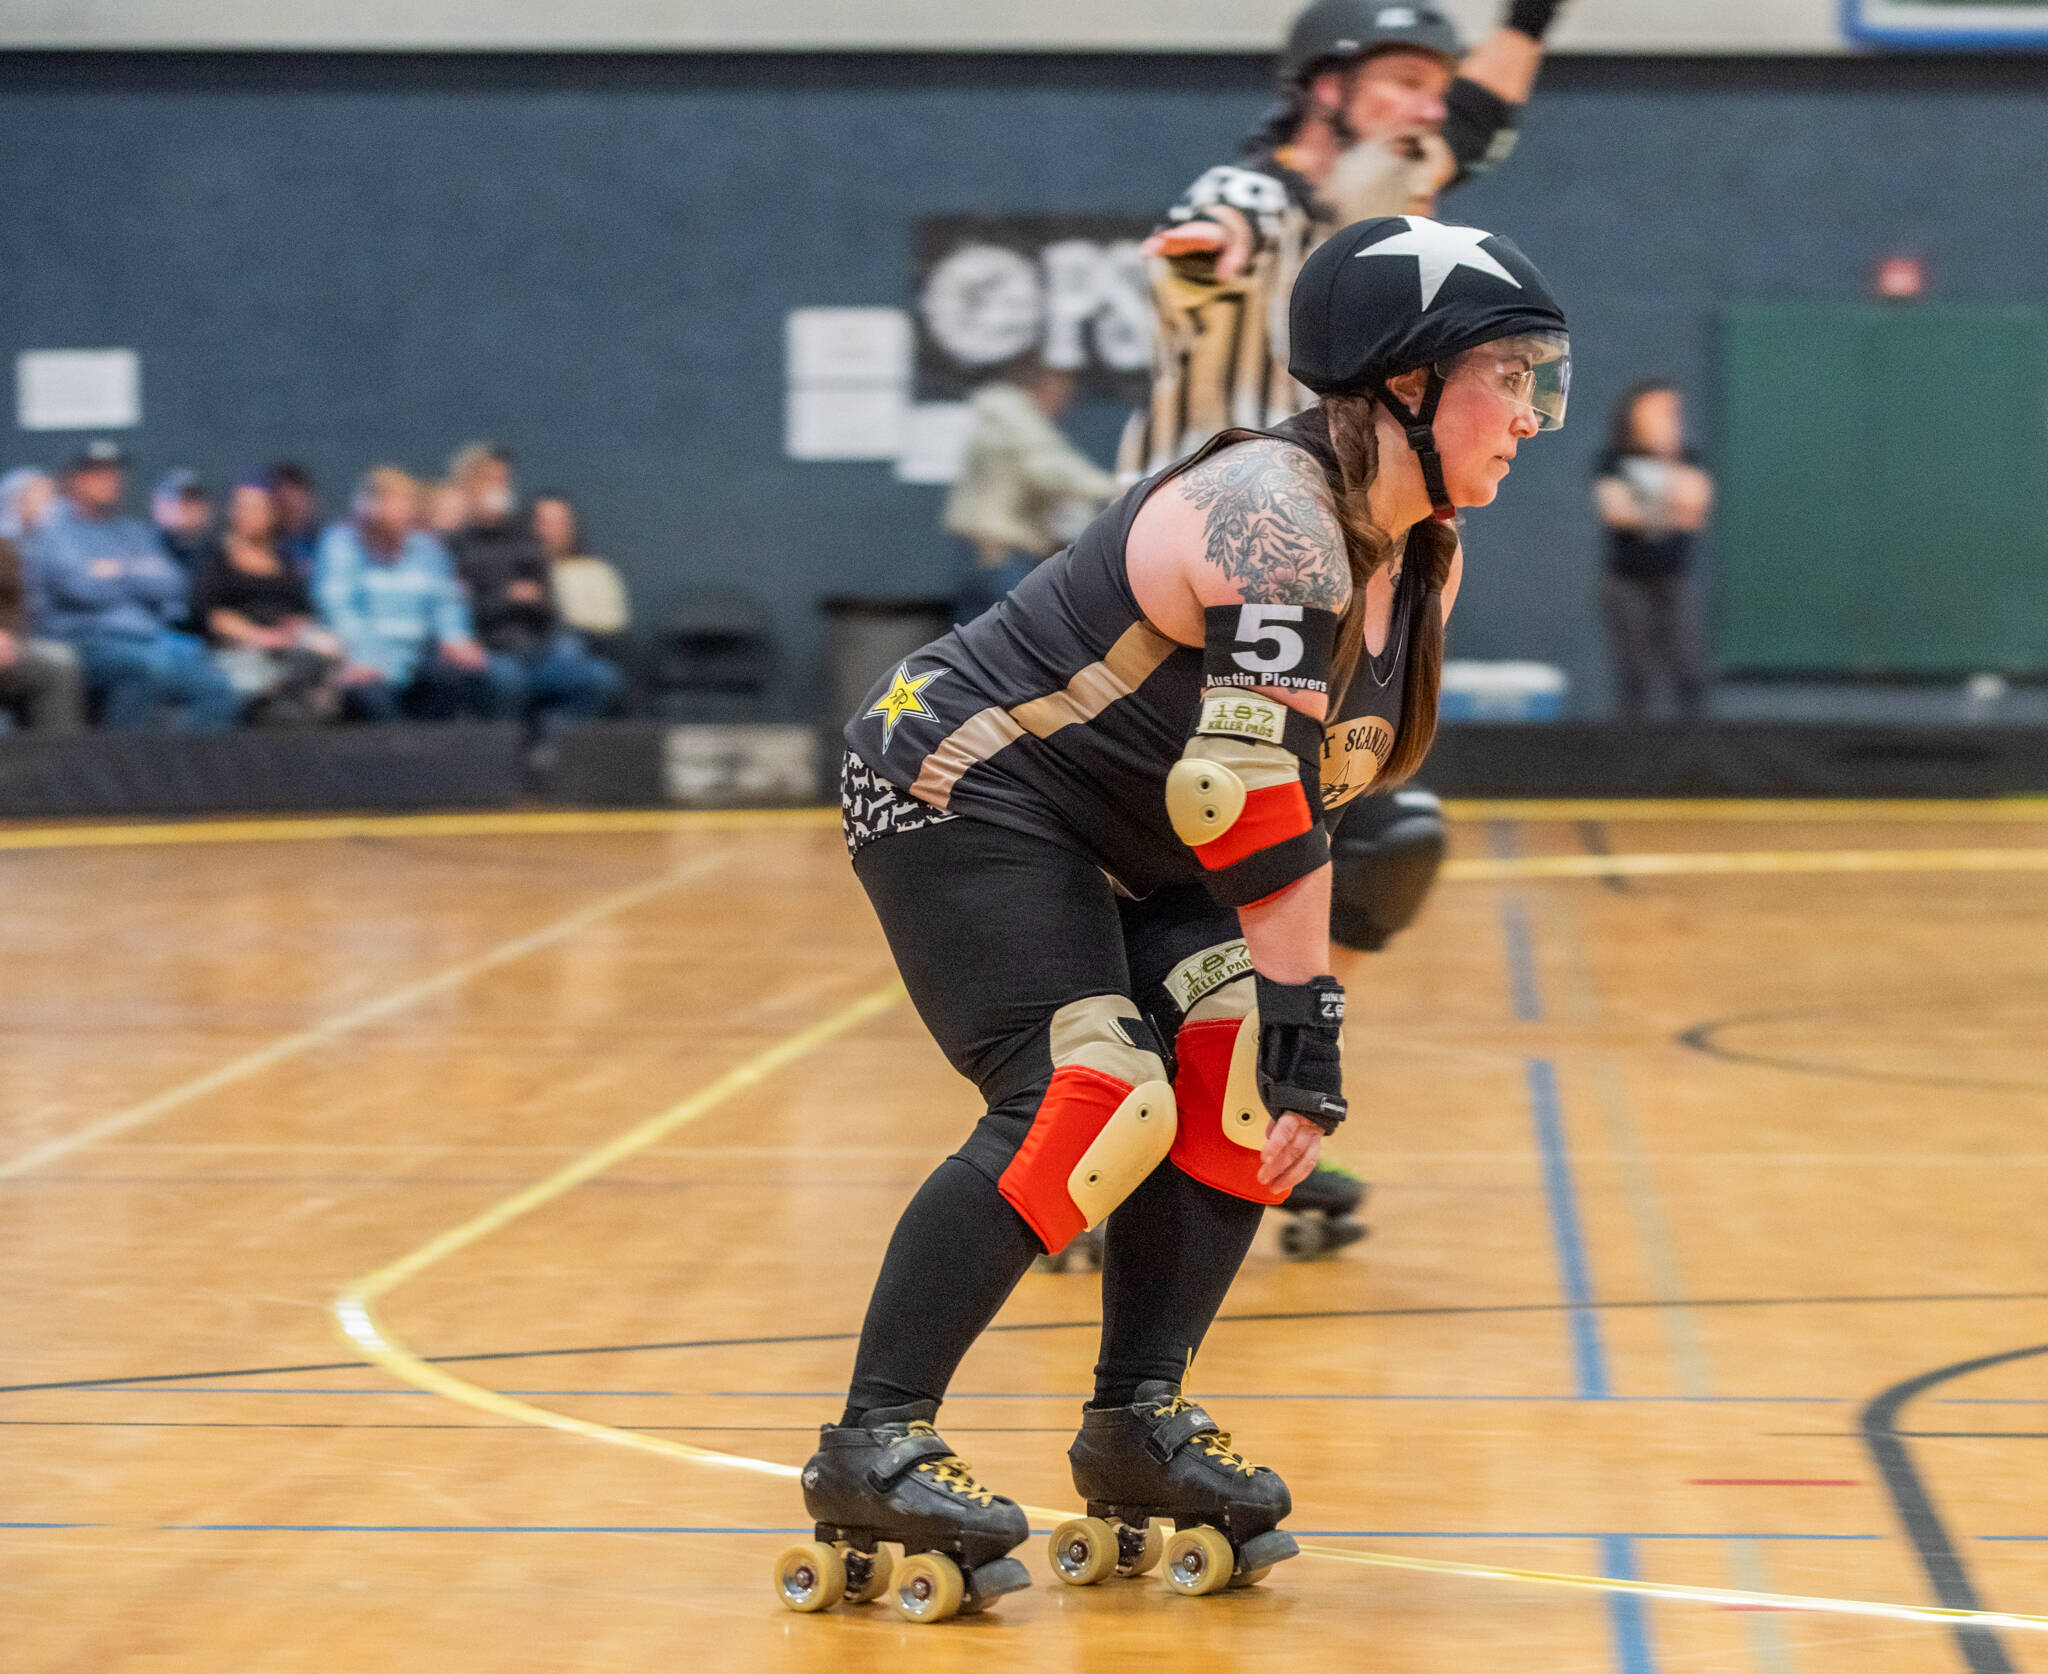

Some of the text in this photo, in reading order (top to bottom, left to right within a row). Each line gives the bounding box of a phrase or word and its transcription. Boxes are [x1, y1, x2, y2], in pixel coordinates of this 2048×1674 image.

[1231, 603, 1304, 673] 5
[1206, 672, 1328, 692] Austin Plowers
[1207, 720, 1243, 731] KILLER
[1215, 704, 1274, 723] 187
[1183, 944, 1248, 988] 187
[1186, 970, 1226, 1002] KILLER
